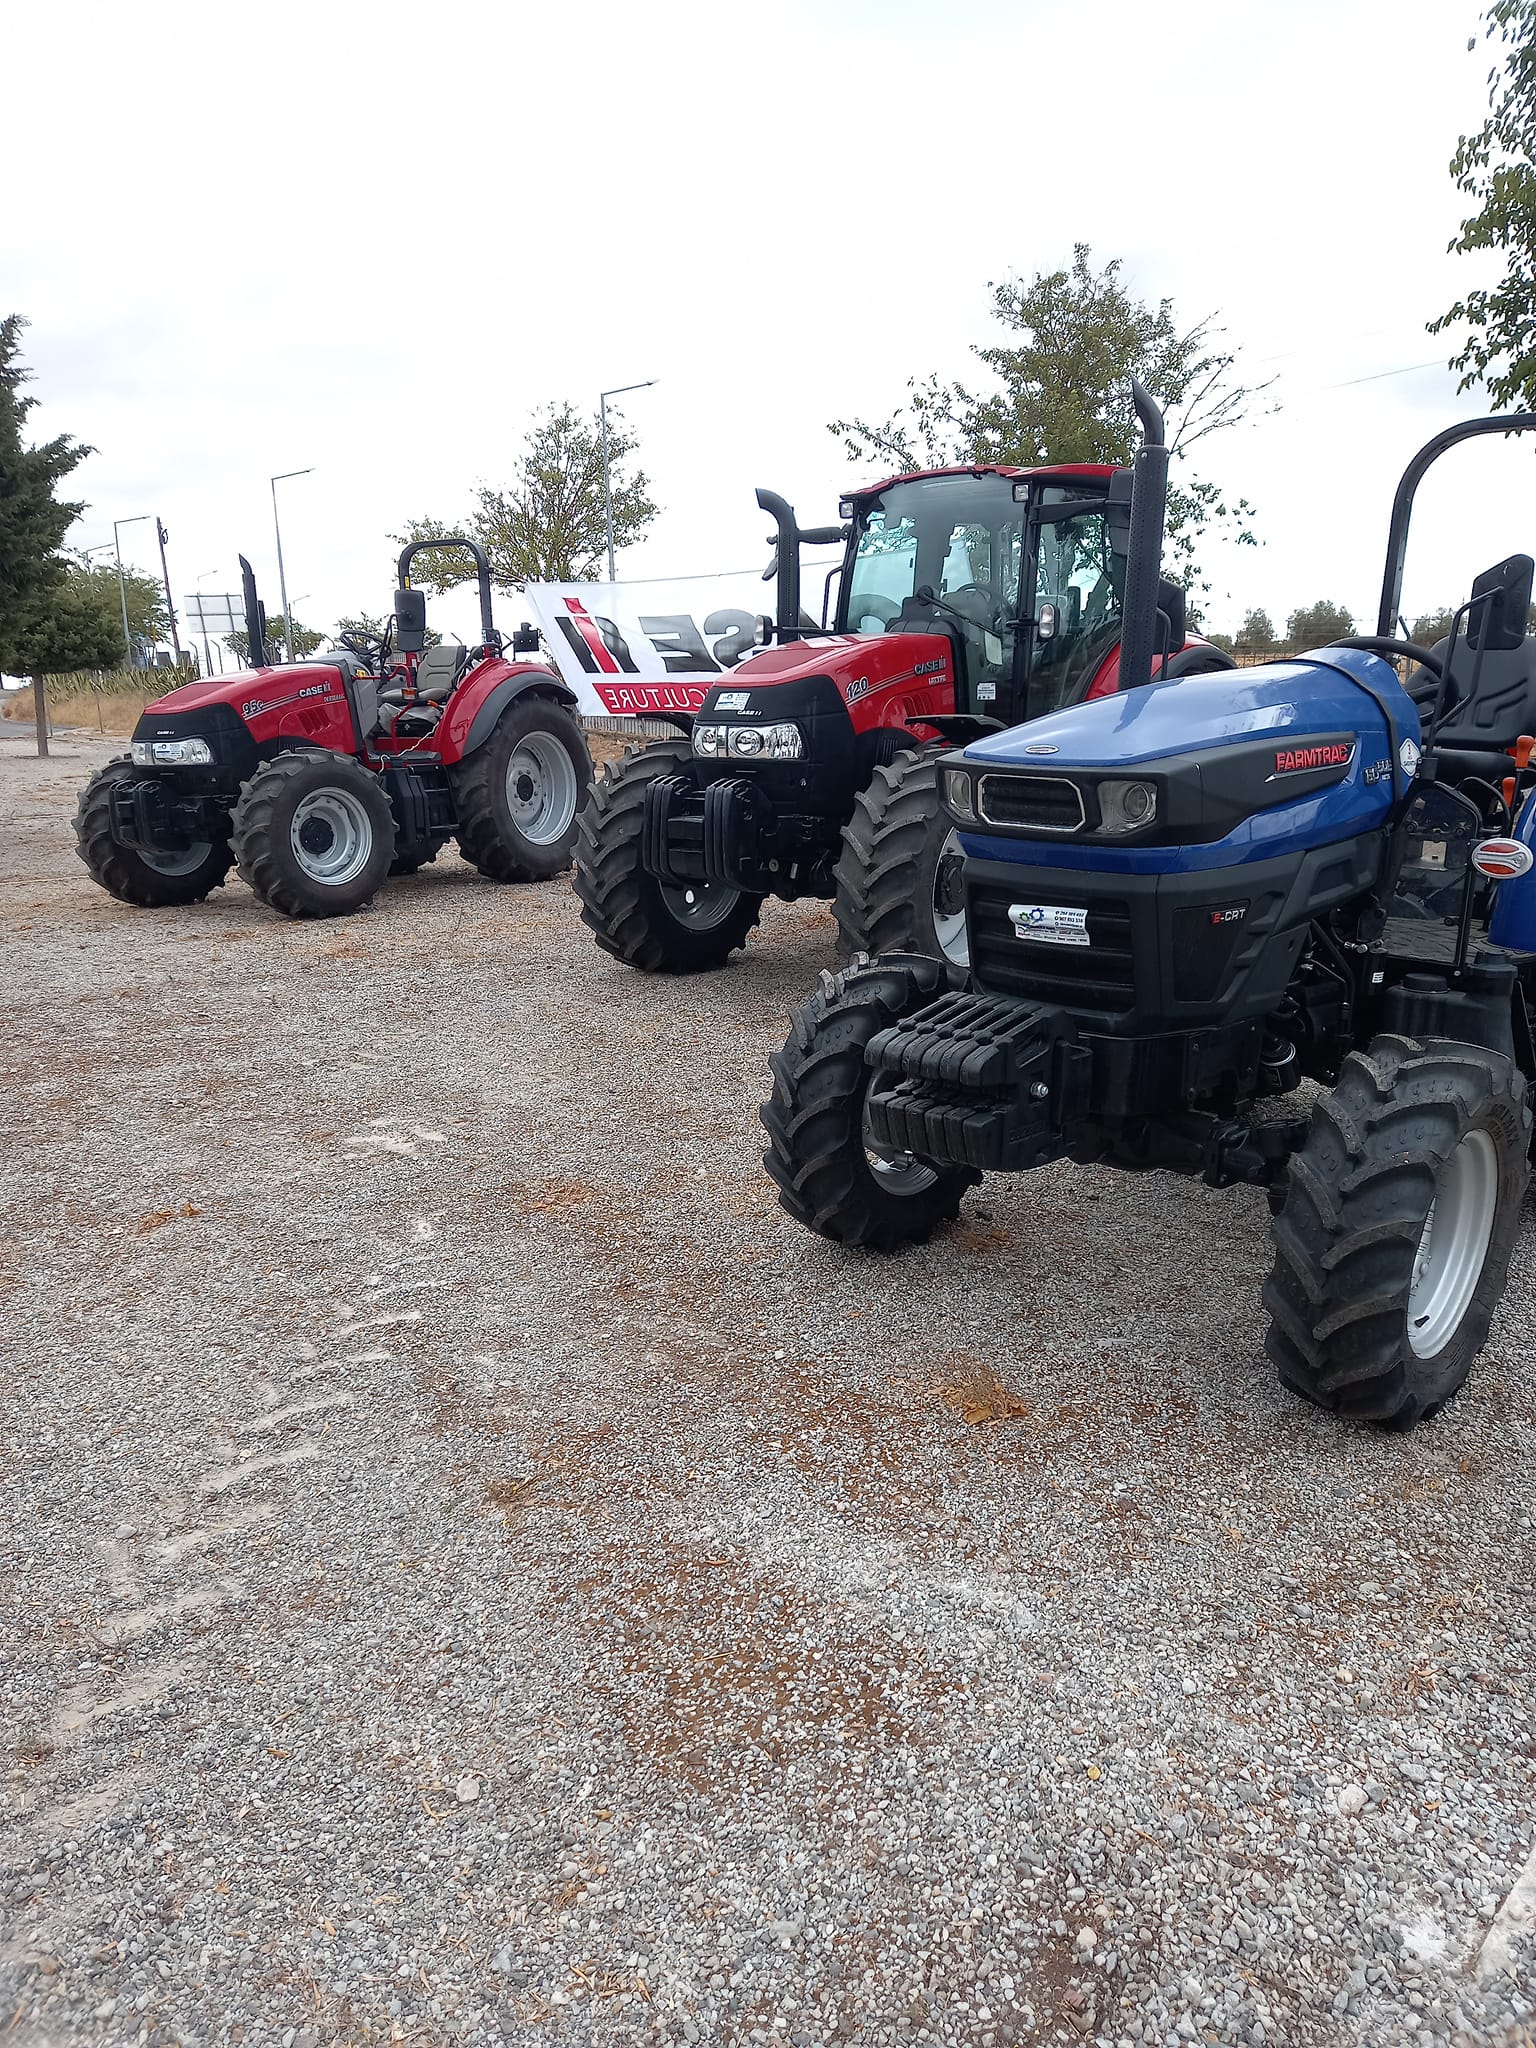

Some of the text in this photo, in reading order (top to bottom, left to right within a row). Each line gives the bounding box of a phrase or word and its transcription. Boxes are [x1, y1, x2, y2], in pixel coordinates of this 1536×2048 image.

[914, 659, 938, 675] CASE
[299, 684, 323, 698] CASE
[846, 676, 869, 700] 120
[1276, 743, 1349, 772] FARMTRAC
[1213, 908, 1246, 925] E-CRT
